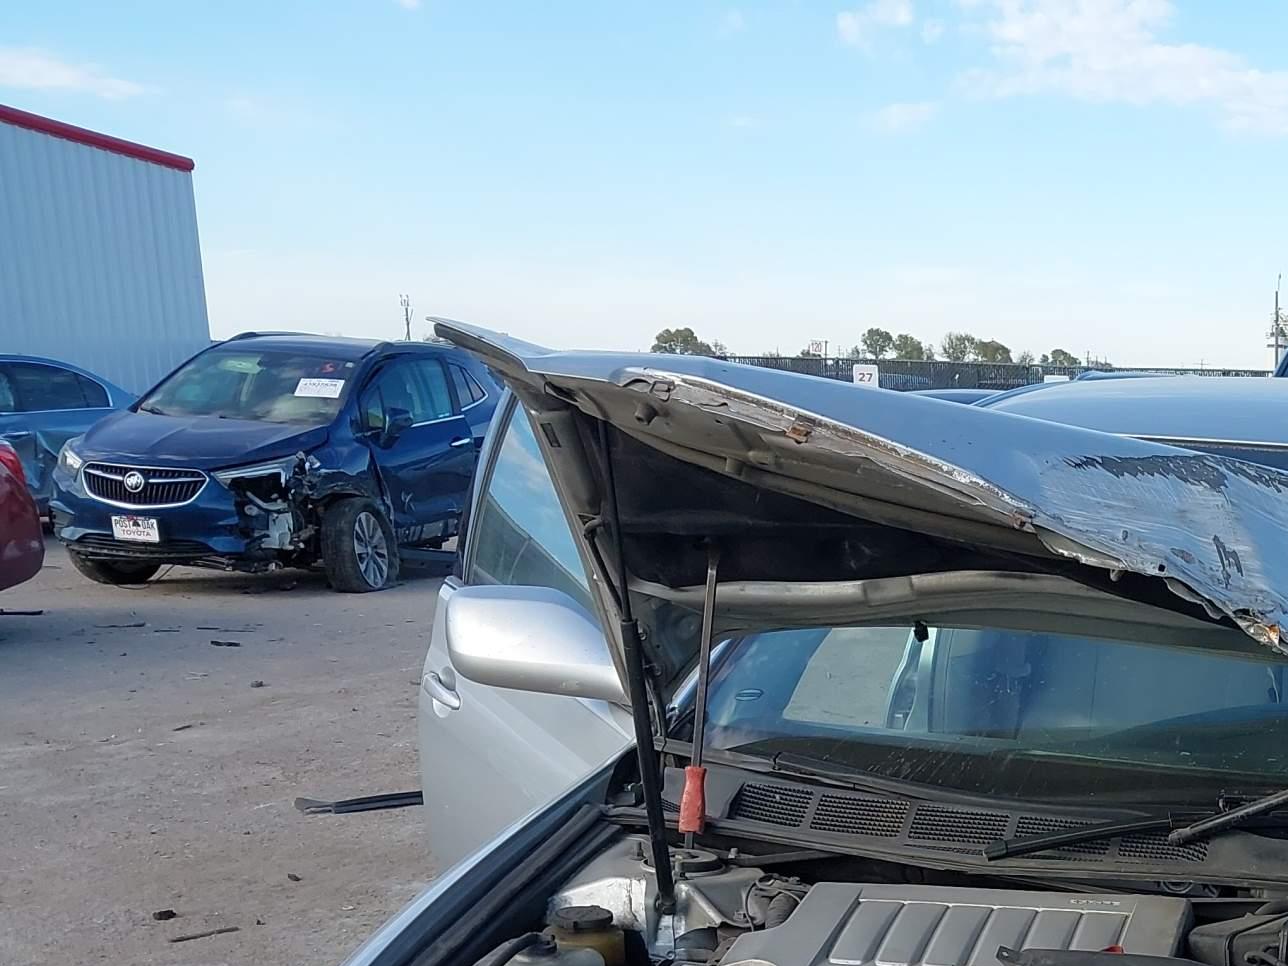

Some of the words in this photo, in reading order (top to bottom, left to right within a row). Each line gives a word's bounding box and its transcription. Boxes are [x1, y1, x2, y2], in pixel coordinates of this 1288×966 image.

[858, 372, 873, 382] 27
[114, 518, 132, 529] POST
[122, 529, 152, 537] TOYOTA
